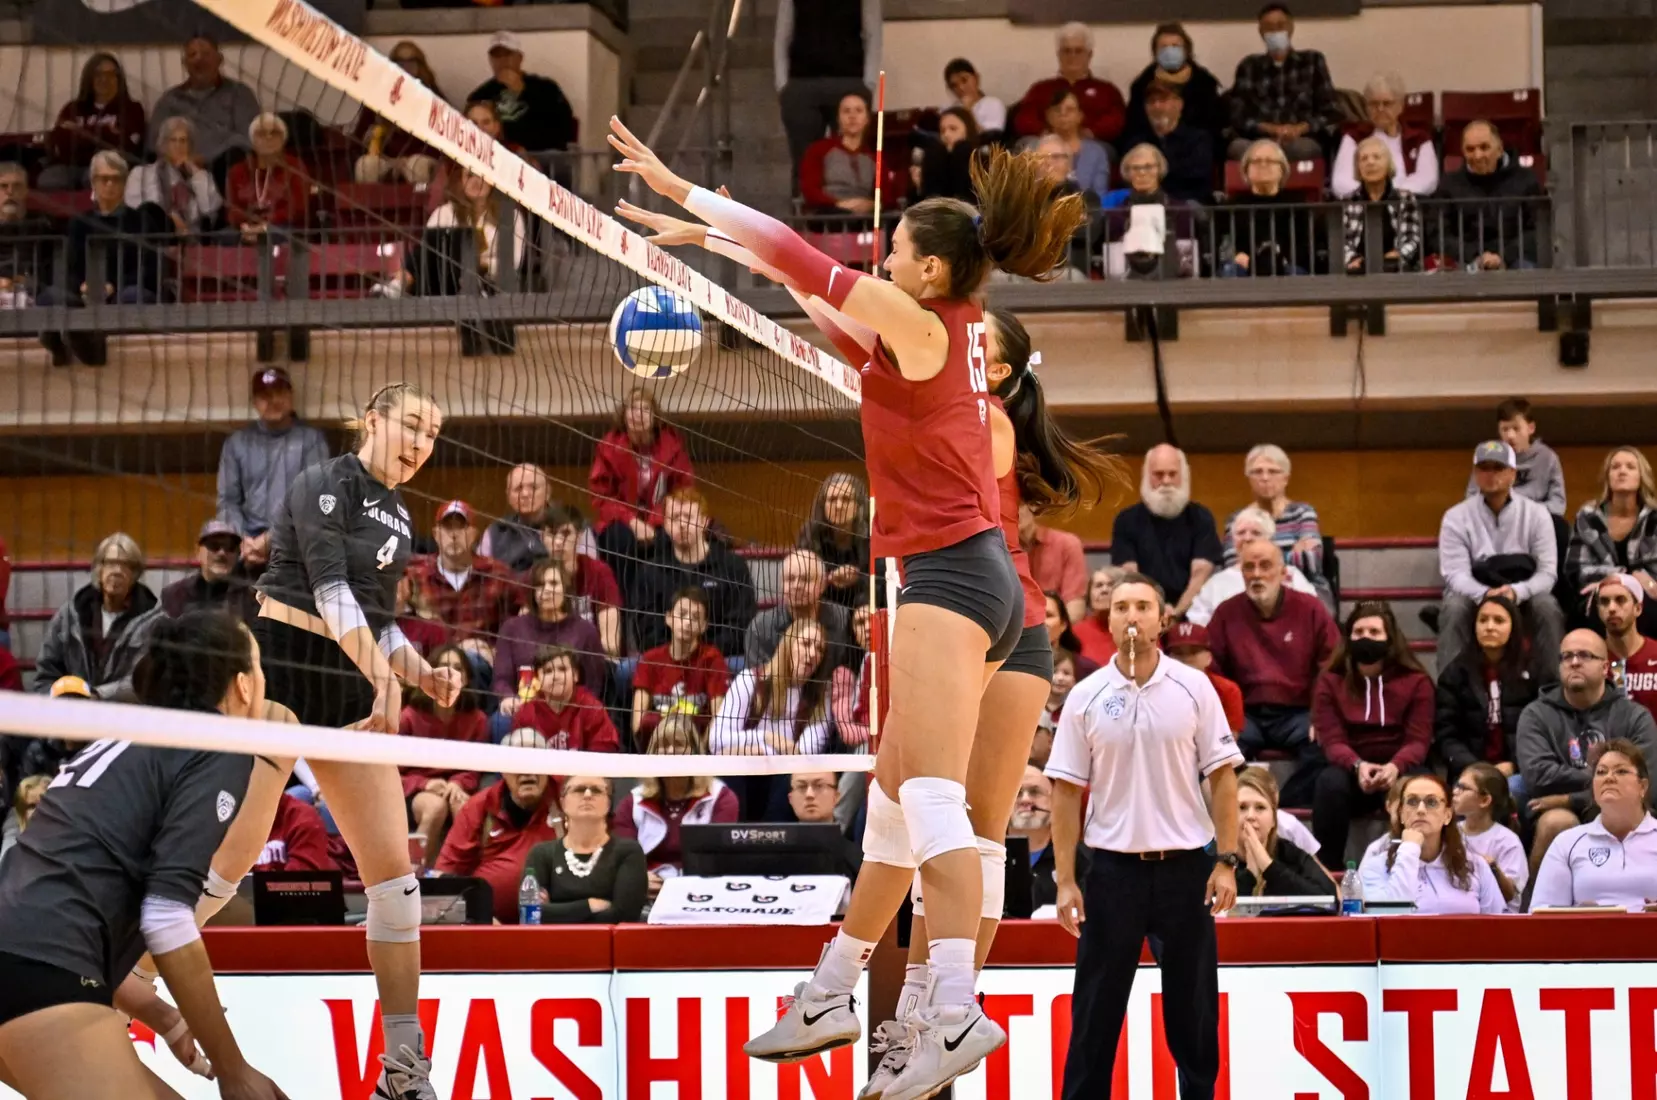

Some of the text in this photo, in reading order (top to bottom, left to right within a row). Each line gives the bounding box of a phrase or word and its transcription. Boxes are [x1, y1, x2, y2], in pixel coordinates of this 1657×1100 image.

[966, 322, 987, 389] 15
[362, 507, 411, 539] OLORAD
[376, 535, 399, 570] 4
[1179, 623, 1193, 637] W
[47, 738, 133, 788] 21
